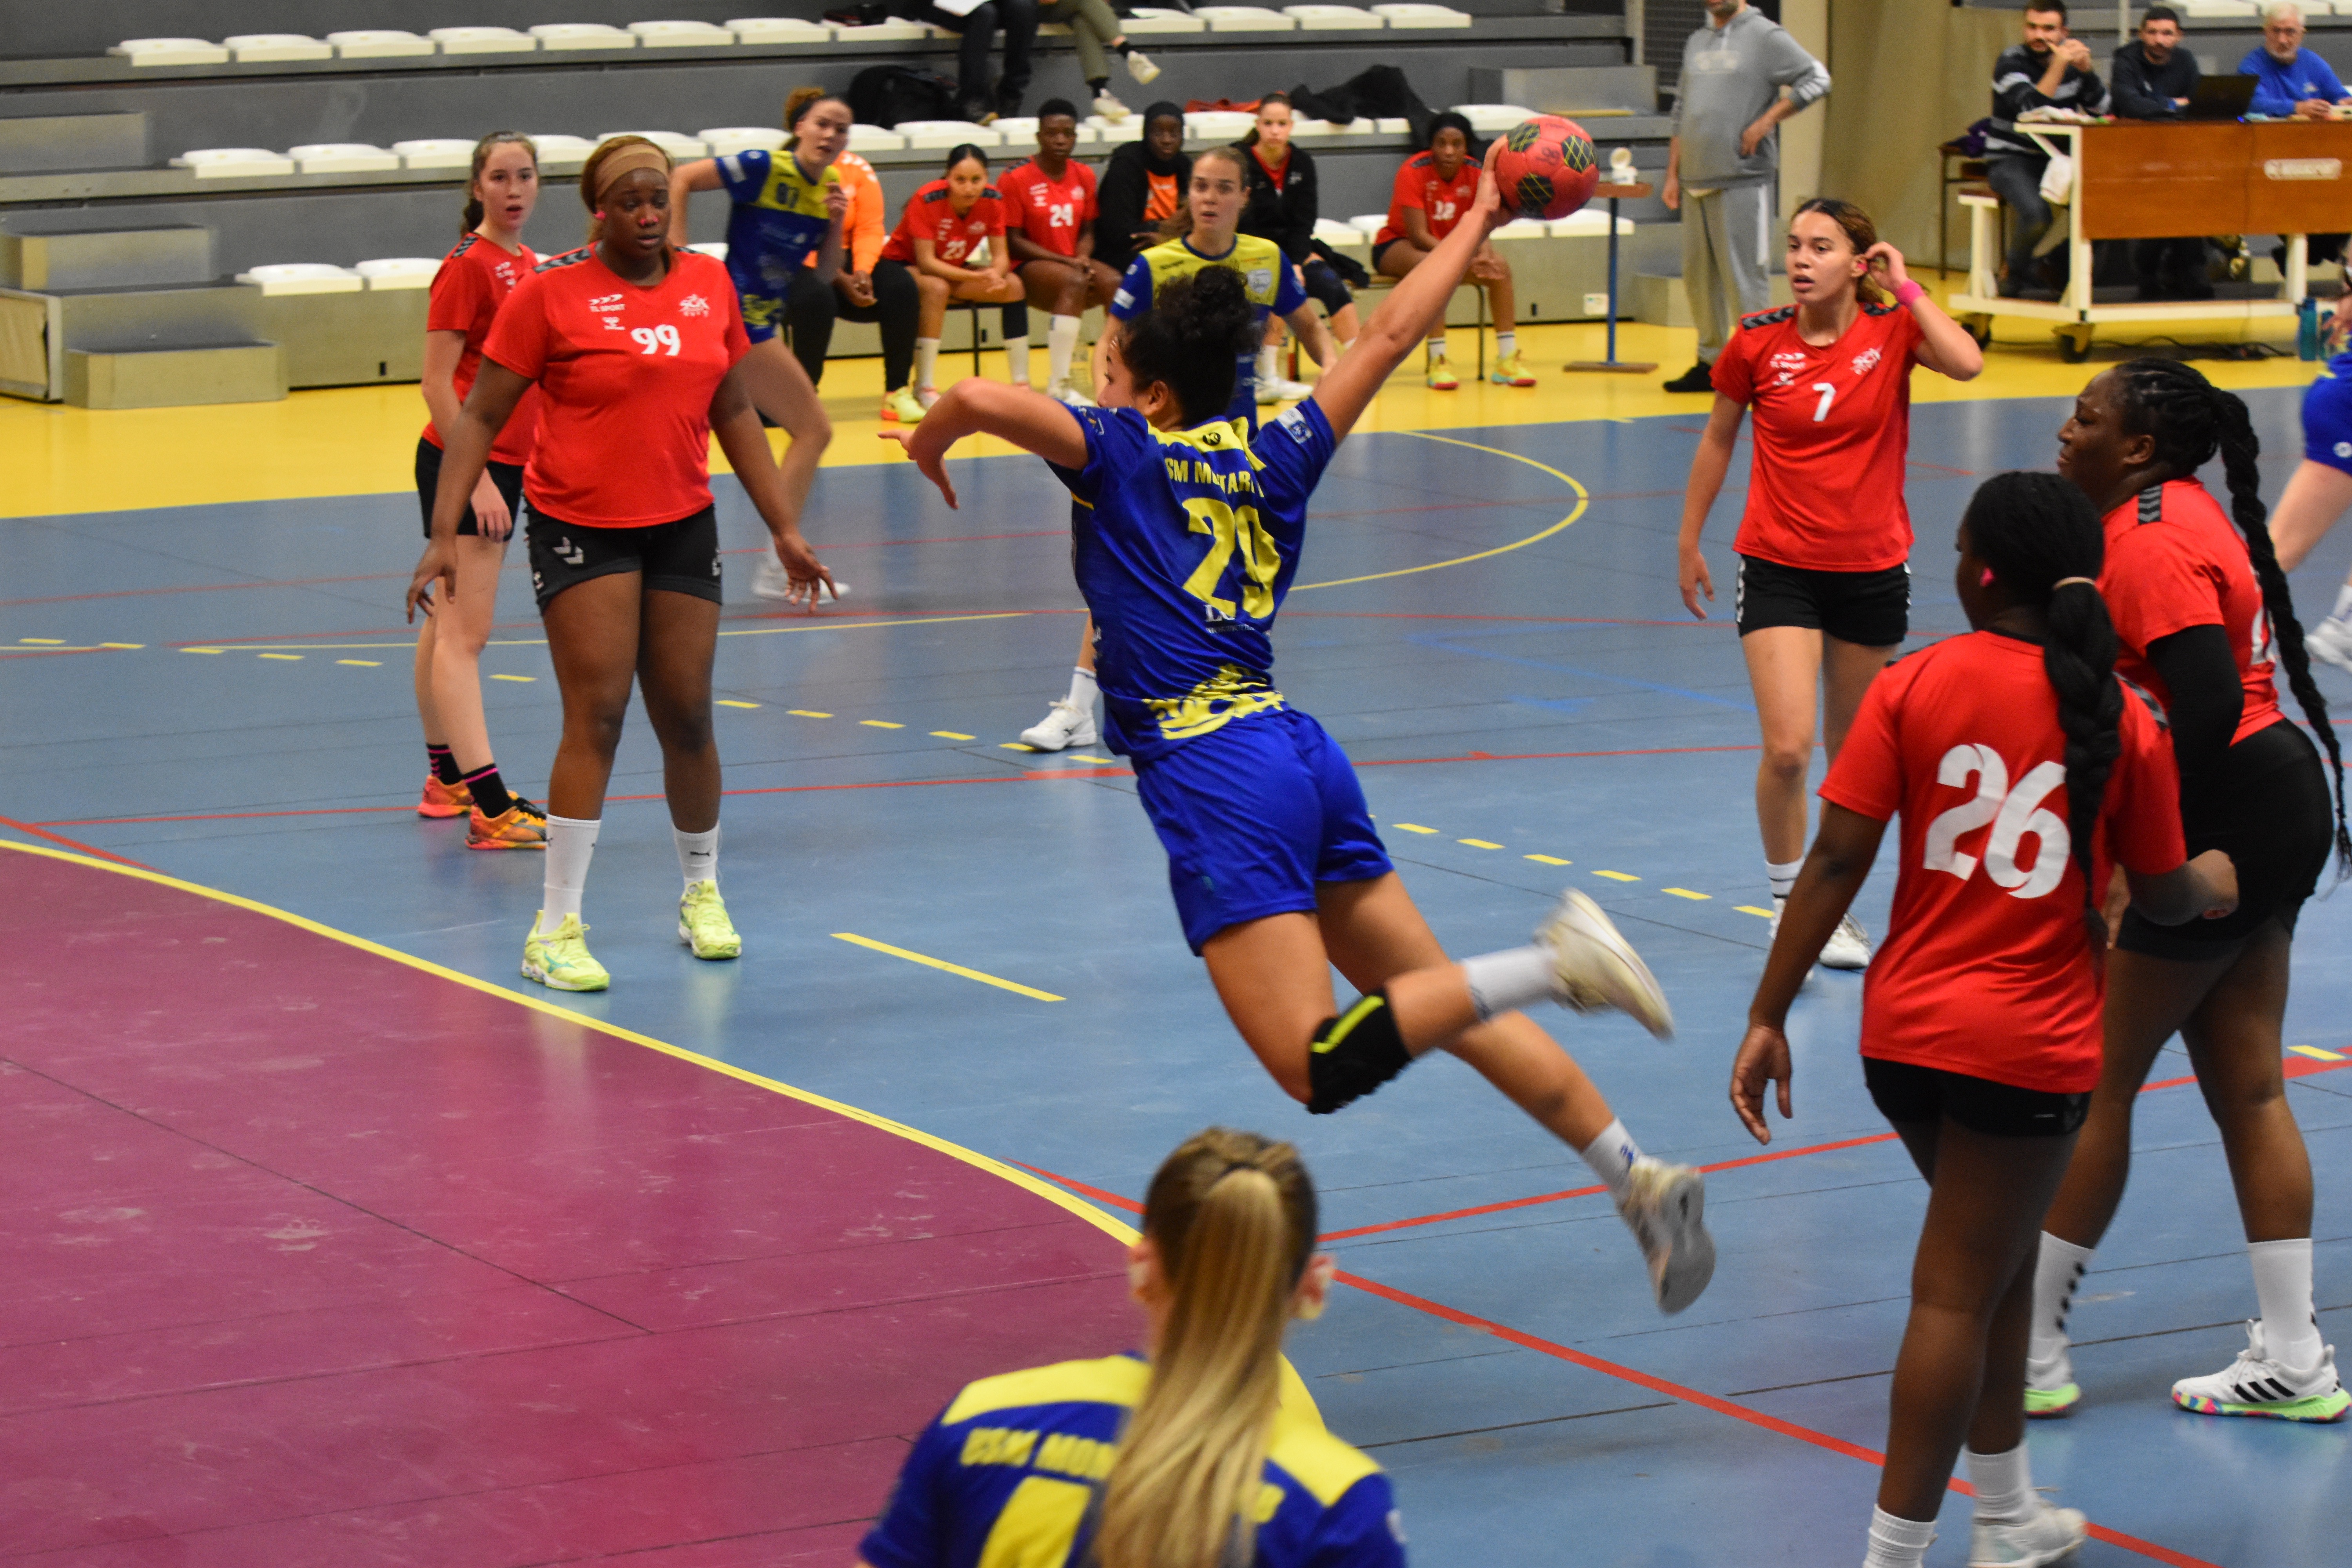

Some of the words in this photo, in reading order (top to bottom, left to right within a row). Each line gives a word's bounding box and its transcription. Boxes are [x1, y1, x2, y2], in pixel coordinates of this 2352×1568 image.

[1049, 203, 1074, 228] 24
[630, 324, 681, 356] 99
[1812, 382, 1837, 422] 7
[1181, 497, 1281, 619] 29
[1923, 742, 2072, 899] 26
